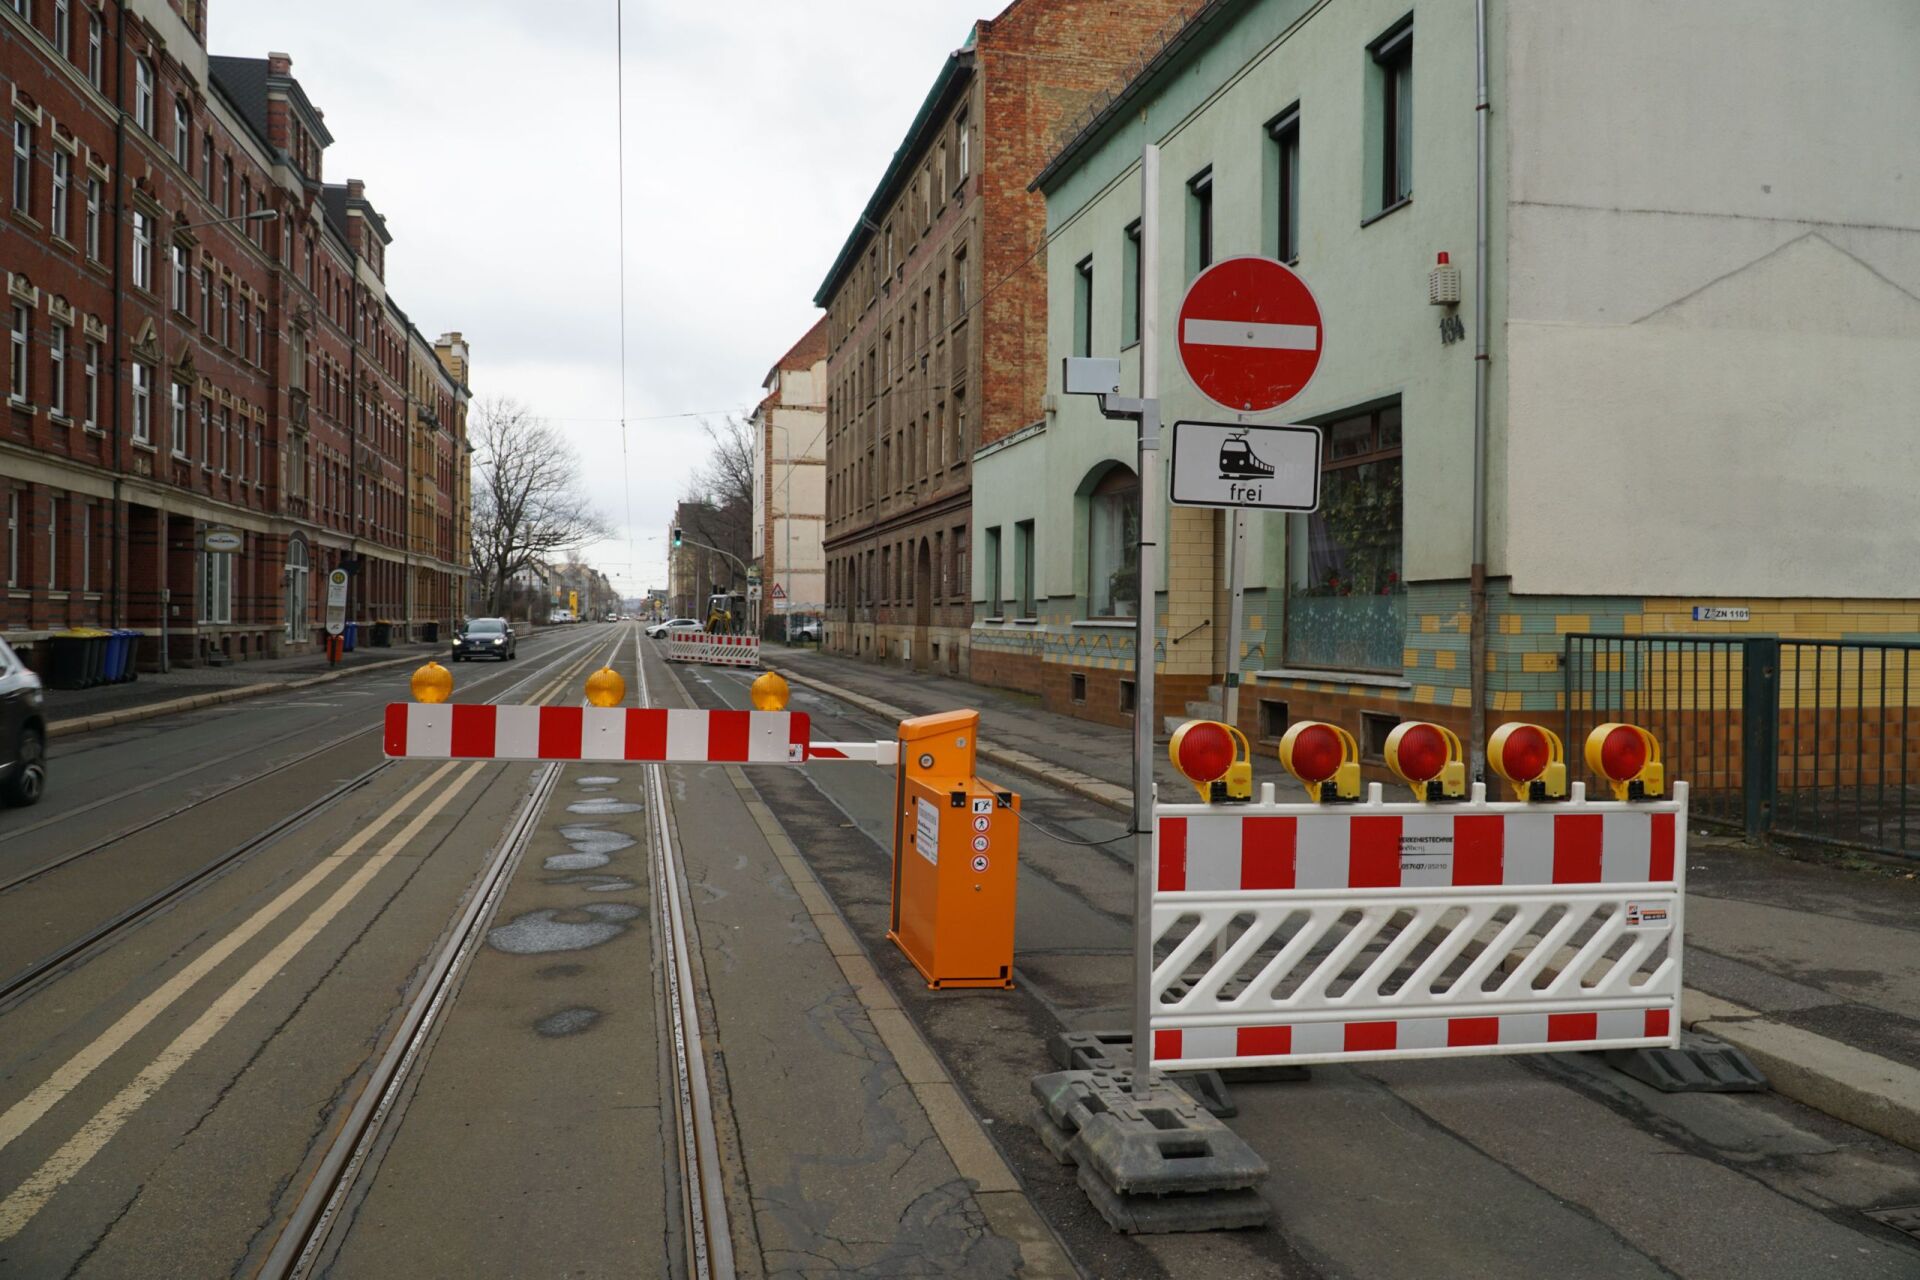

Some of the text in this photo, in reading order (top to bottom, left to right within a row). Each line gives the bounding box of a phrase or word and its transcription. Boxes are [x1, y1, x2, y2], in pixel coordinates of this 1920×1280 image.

[1230, 483, 1262, 502] frei
[1704, 608, 1749, 619] Z ZN 1101
